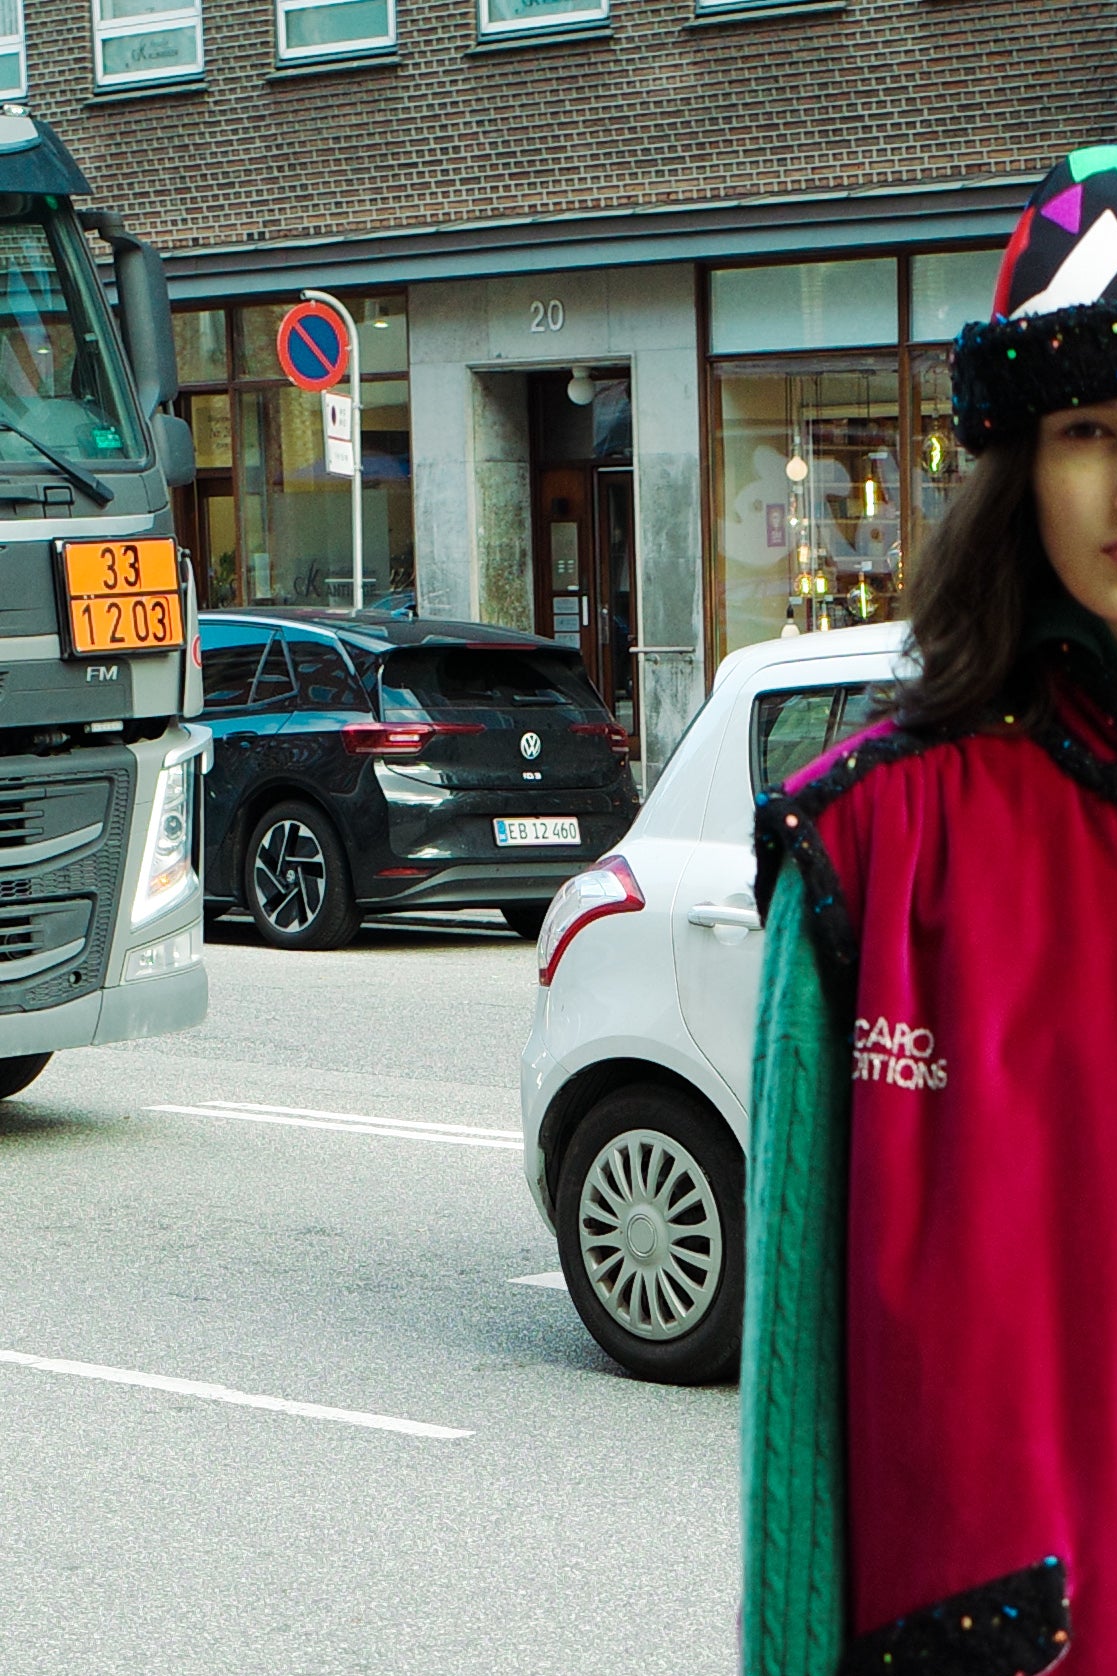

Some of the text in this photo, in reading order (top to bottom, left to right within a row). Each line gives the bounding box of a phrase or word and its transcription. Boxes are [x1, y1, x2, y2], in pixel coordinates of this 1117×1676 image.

[530, 300, 564, 331] 20
[100, 545, 141, 590] 33
[82, 599, 168, 645] 1203
[86, 665, 118, 681] FM
[508, 822, 577, 840] EB 12 460
[854, 1016, 934, 1058] CARO
